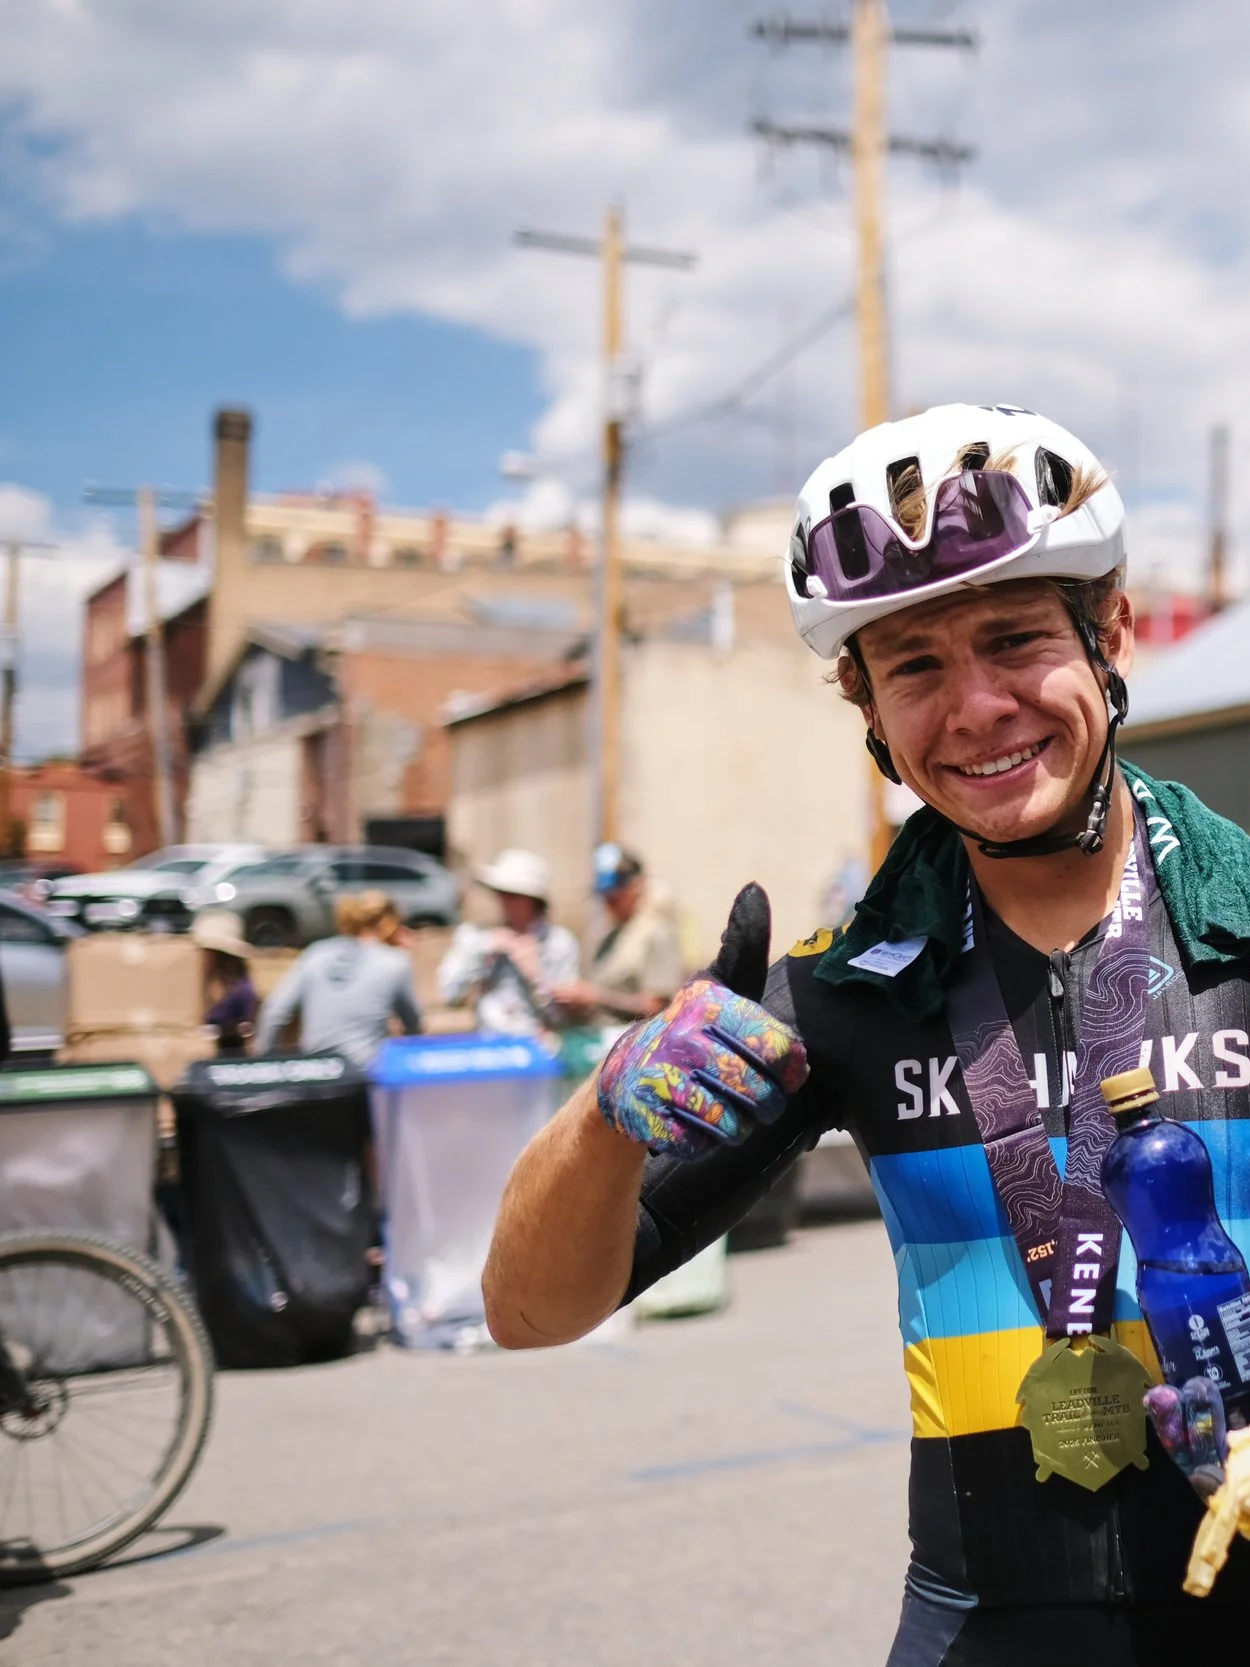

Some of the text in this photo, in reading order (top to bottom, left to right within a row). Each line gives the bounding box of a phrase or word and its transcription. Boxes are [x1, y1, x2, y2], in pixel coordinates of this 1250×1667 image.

[1051, 1395, 1120, 1412] LEADVILLE
[1042, 1411, 1081, 1425] TRAIL
[1103, 1404, 1131, 1417] MTB
